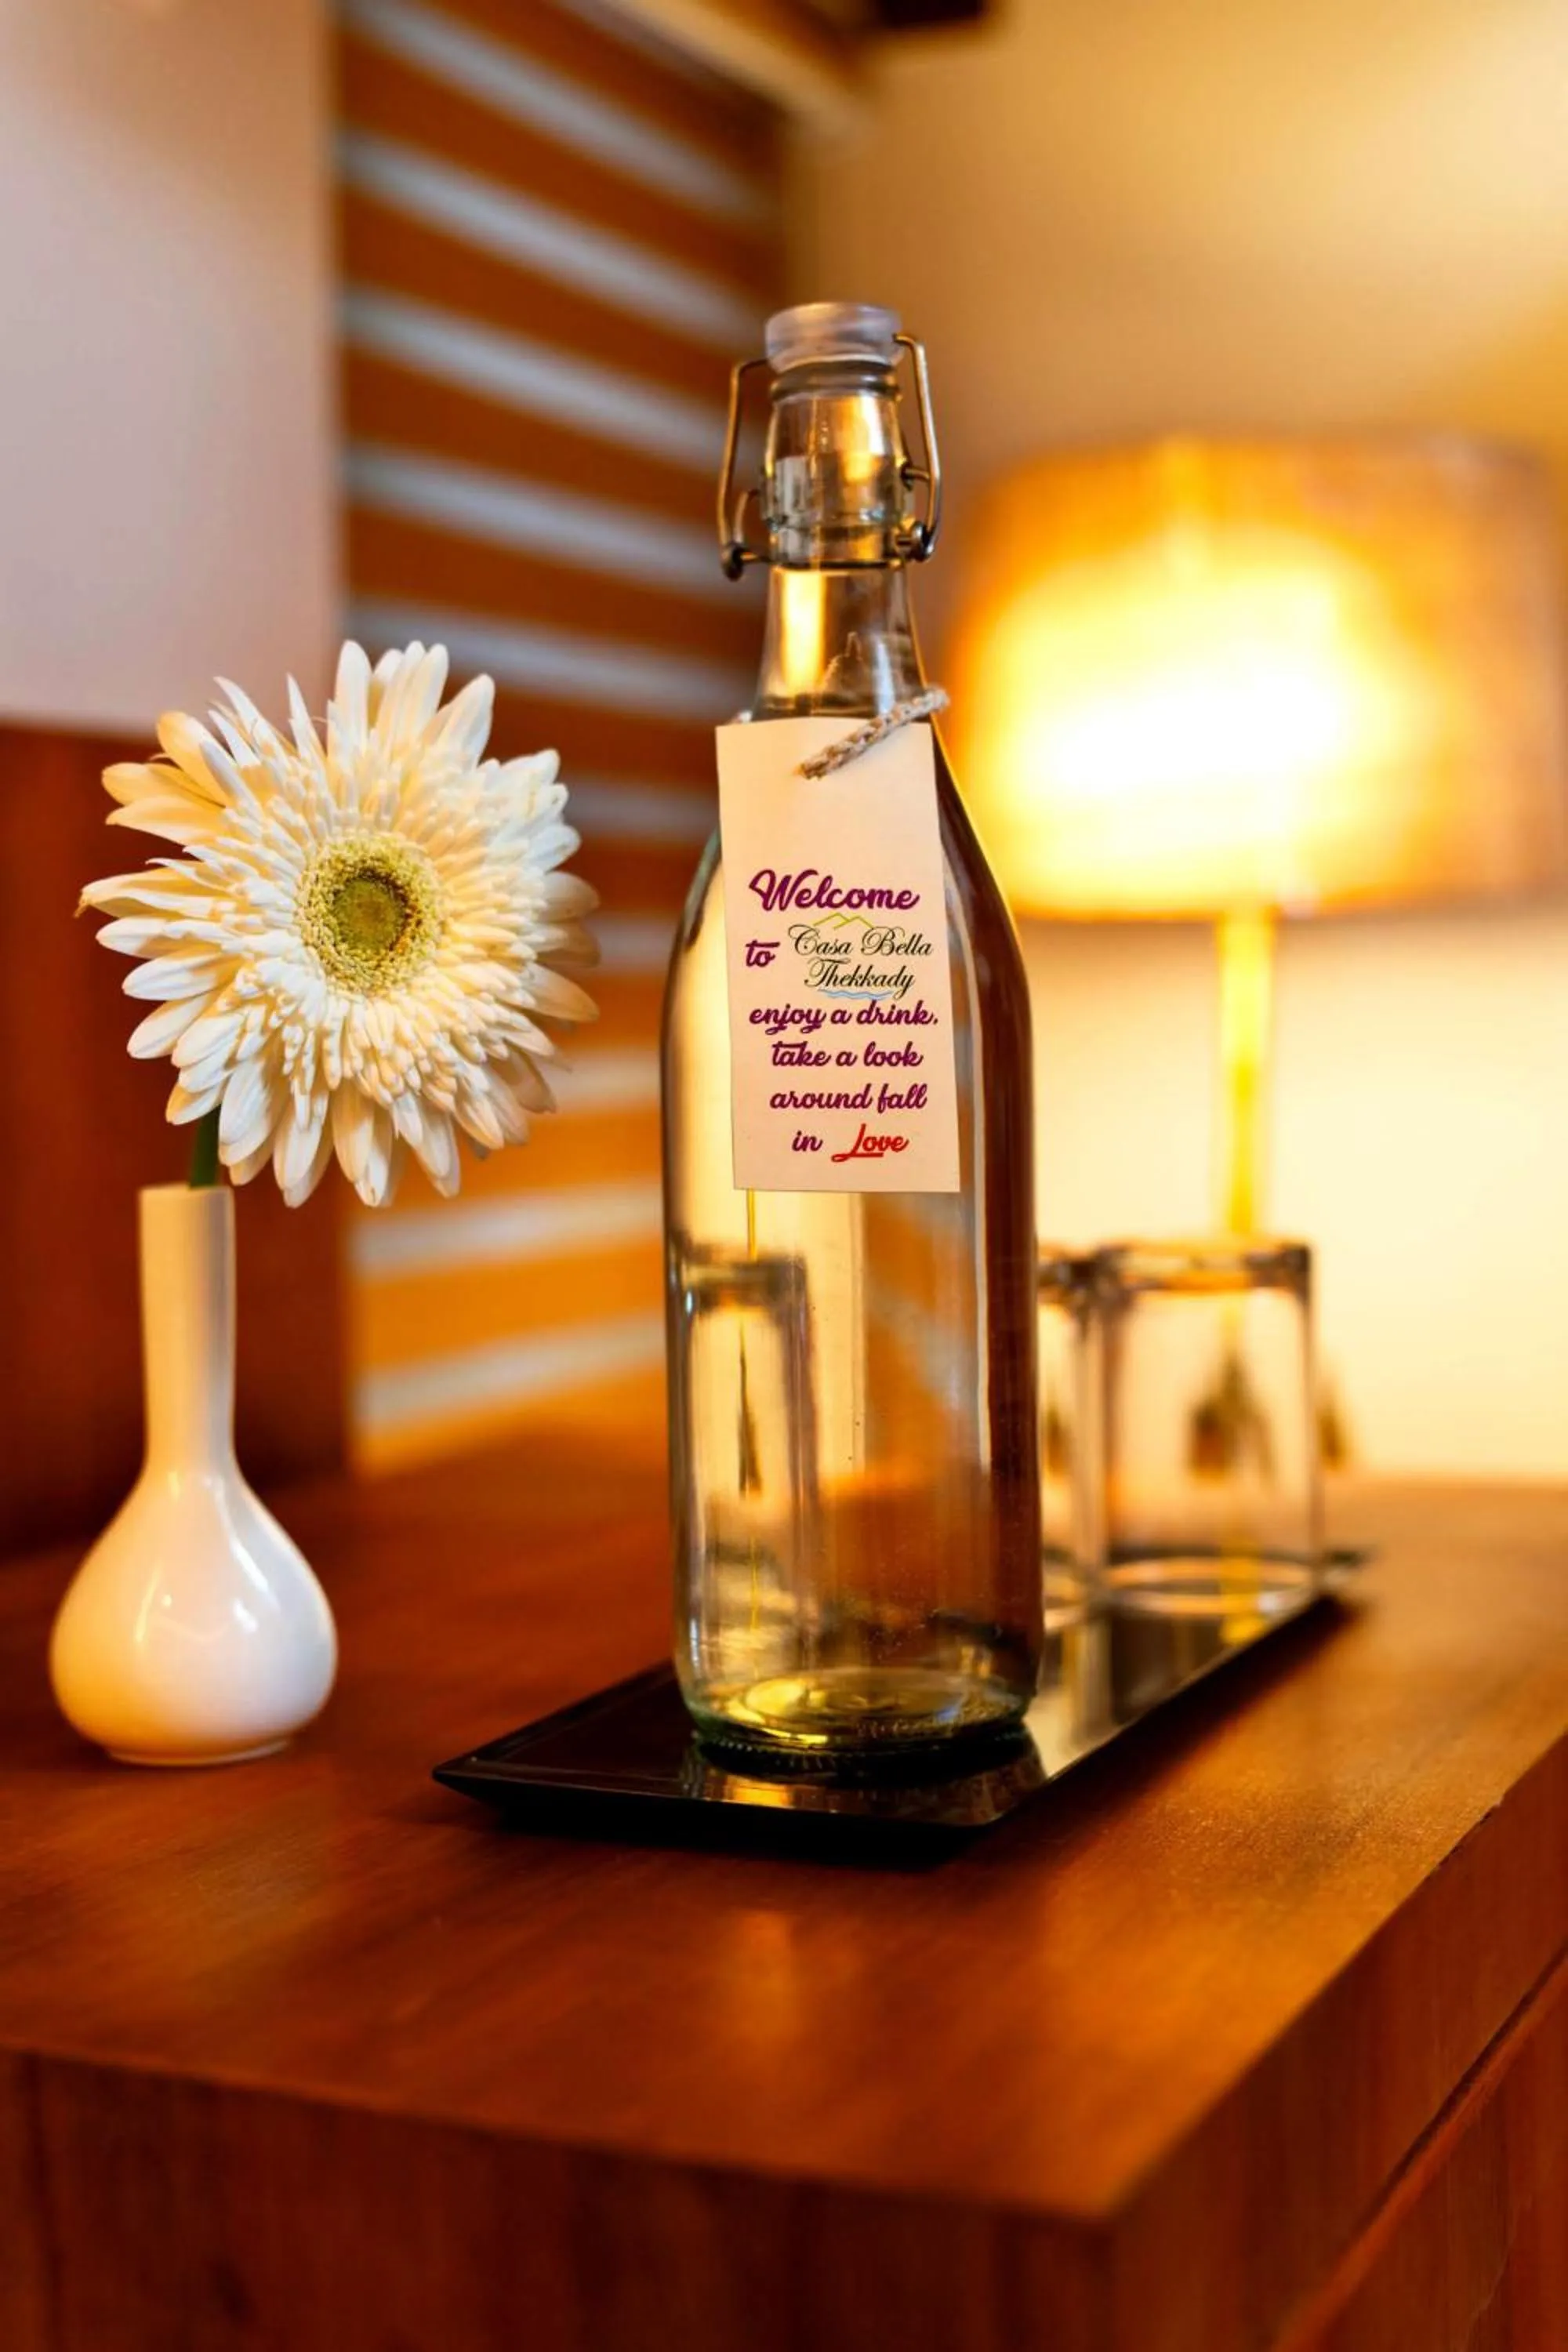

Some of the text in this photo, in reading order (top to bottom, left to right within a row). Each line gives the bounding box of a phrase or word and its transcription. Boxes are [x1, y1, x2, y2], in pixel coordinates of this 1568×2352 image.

[749, 869, 920, 911] Welcome
[746, 924, 932, 967] to Casa Bella
[804, 958, 915, 1000] Thekkady
[749, 1004, 826, 1035] enjoy
[830, 1008, 852, 1025] a
[771, 1041, 924, 1067] take a look
[770, 1083, 927, 1114] around fall
[792, 1123, 909, 1162] in Love
